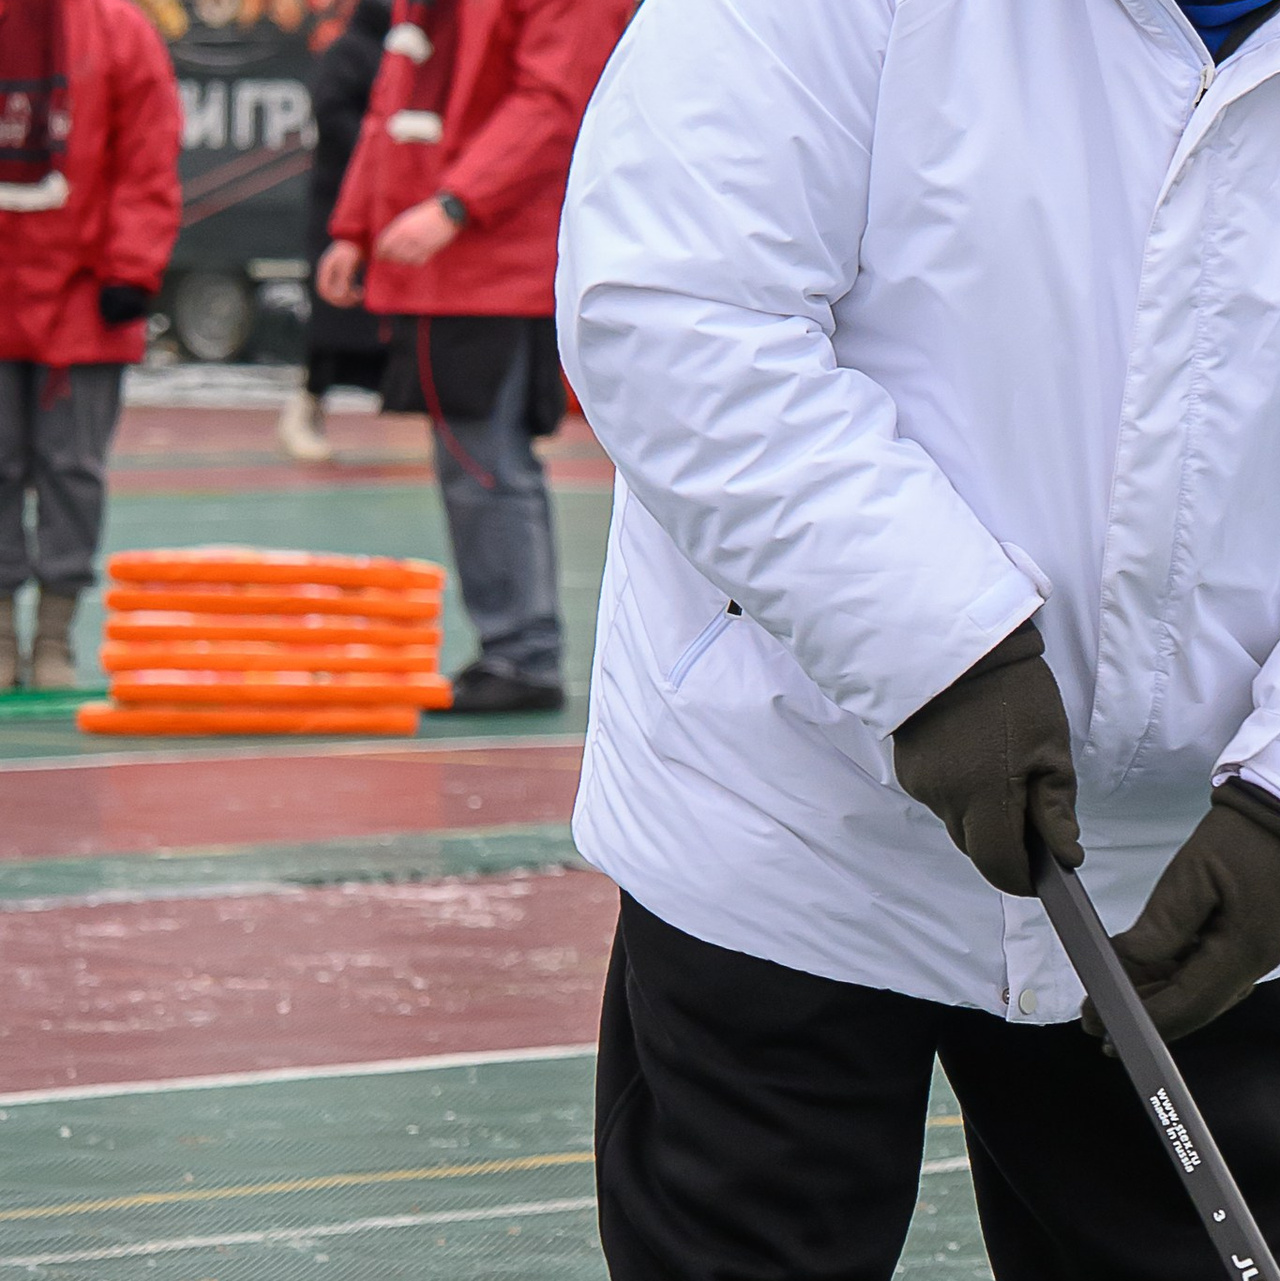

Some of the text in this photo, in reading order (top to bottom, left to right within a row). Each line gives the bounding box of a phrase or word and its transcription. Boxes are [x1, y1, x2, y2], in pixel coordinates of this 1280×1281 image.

[1149, 1095, 1194, 1173] made in russia
[1156, 1087, 1201, 1166] www.stex.ru
[1213, 1209, 1226, 1222] 3
